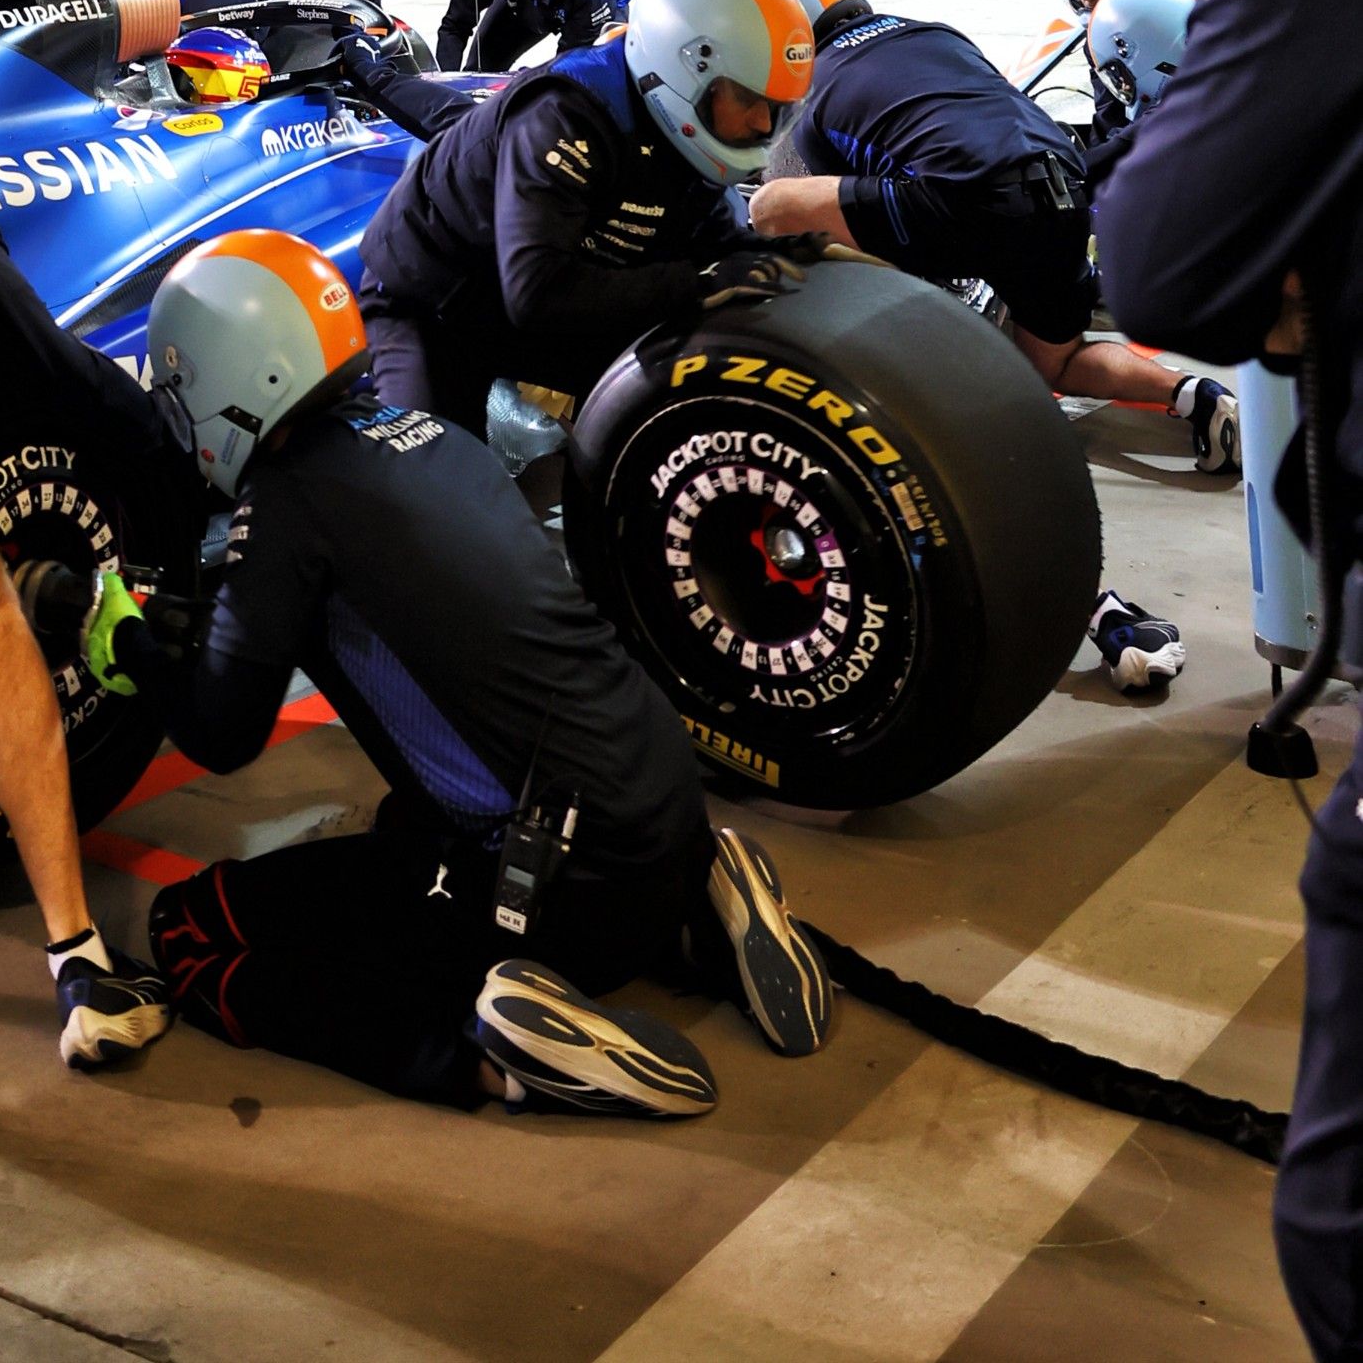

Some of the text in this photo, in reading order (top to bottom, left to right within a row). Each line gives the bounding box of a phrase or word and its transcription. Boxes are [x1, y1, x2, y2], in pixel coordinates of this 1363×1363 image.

[218, 9, 255, 22] betway
[296, 8, 330, 21] Stephens
[785, 47, 813, 61] Gulf
[173, 116, 215, 132] Carlos
[282, 115, 360, 153] kraken
[324, 286, 347, 306] BELL
[671, 355, 902, 466] P ZERO
[388, 420, 445, 453] RACING
[21, 445, 76, 470] CITY
[650, 430, 824, 499] JACKPOT CITY
[749, 593, 889, 709] JACKPOT CITY
[679, 714, 780, 788] PIRELL
